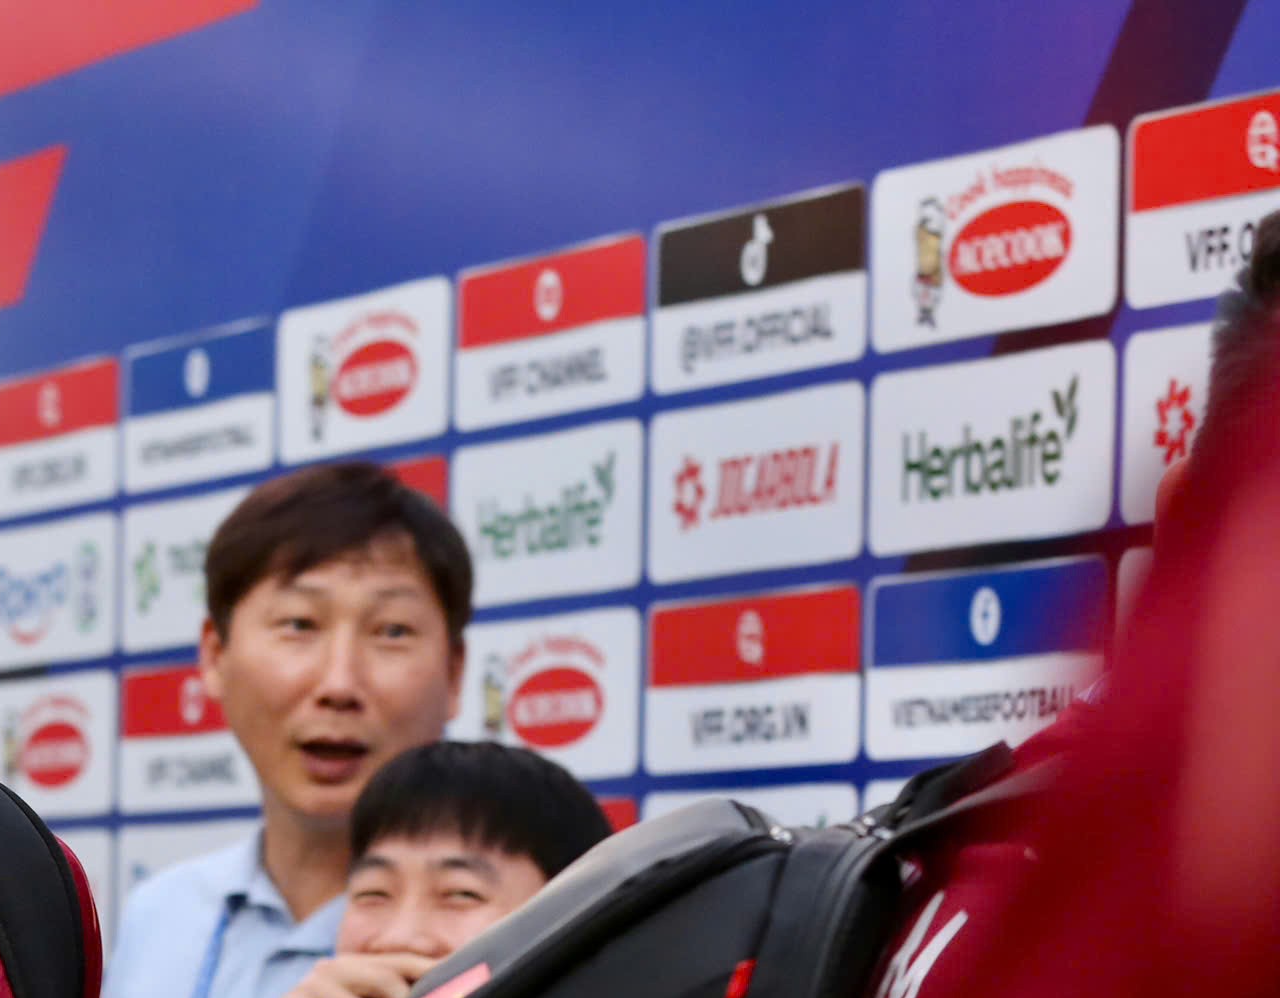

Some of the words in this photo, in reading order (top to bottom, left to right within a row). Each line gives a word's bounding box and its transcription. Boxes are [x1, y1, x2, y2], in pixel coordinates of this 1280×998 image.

[958, 221, 1065, 277] ACECOOK
[710, 442, 841, 520] JOGARBOLA
[901, 410, 1063, 503] Herbalife
[476, 481, 601, 561] Herbalife
